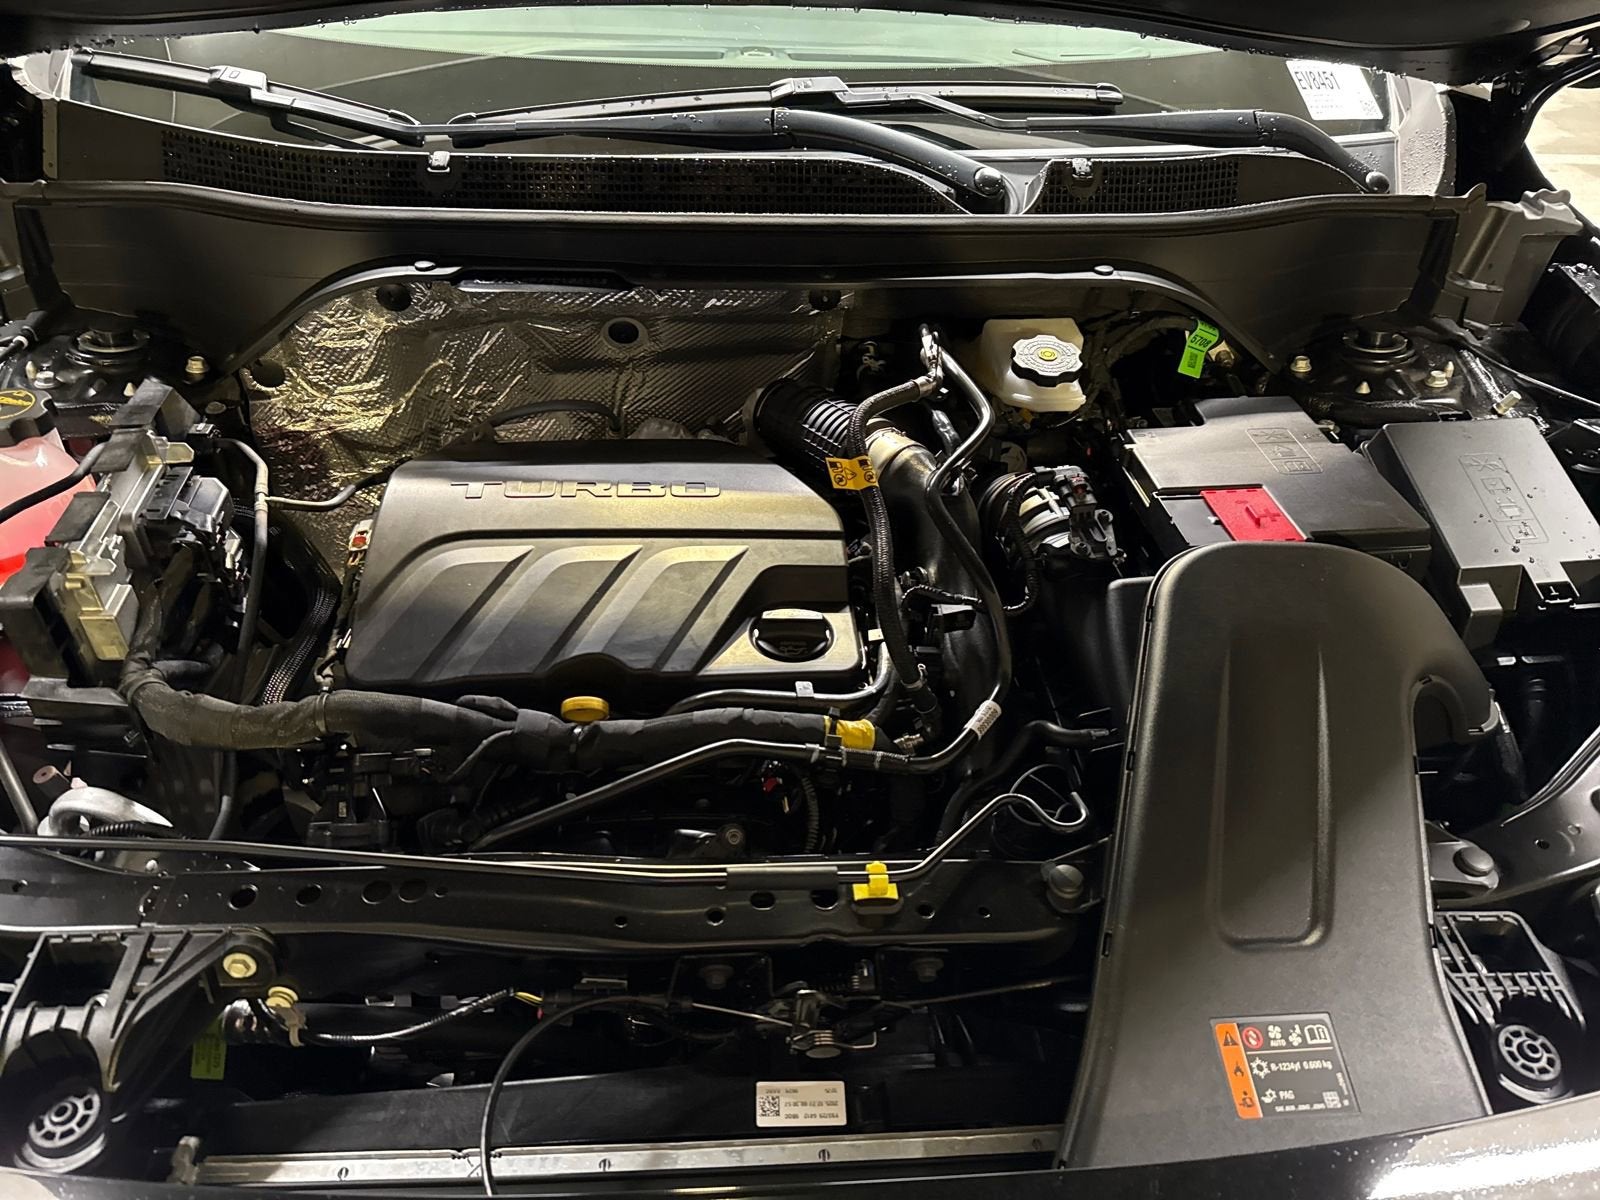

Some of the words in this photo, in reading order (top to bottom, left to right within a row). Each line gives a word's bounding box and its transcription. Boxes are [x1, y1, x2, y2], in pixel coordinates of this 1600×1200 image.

[1294, 71, 1341, 90] EV8451
[450, 480, 721, 499] TURBO
[1270, 1039, 1286, 1047] AUTO
[1270, 1061, 1301, 1072] R-1234yf
[1323, 1059, 1333, 1071] kg
[1279, 1090, 1295, 1100] PAG
